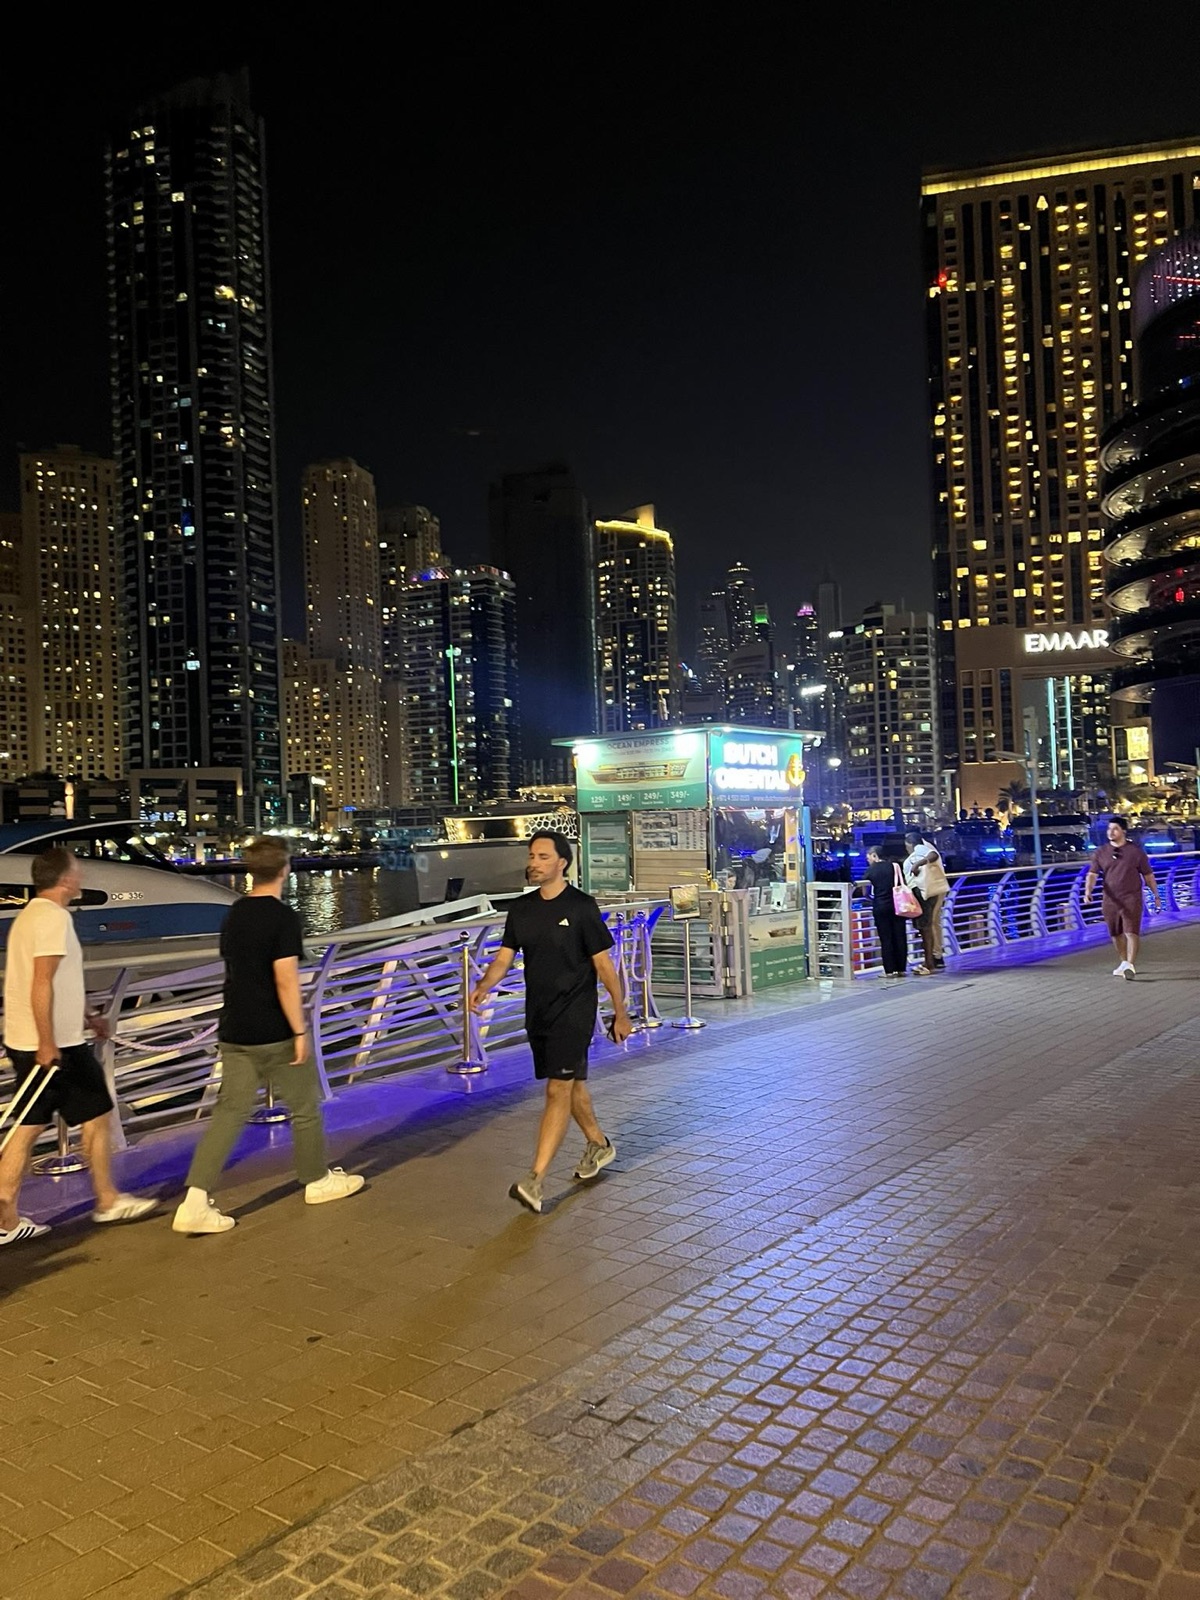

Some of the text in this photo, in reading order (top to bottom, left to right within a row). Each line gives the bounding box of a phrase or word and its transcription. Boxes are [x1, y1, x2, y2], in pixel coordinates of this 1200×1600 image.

[1024, 629, 1110, 652] EMAAR
[607, 738, 670, 750] OCEAN EMPRESS
[723, 742, 778, 766] DUTCH
[643, 792, 663, 800] 249/-
[670, 790, 690, 799] 349/-
[128, 892, 144, 900] 336
